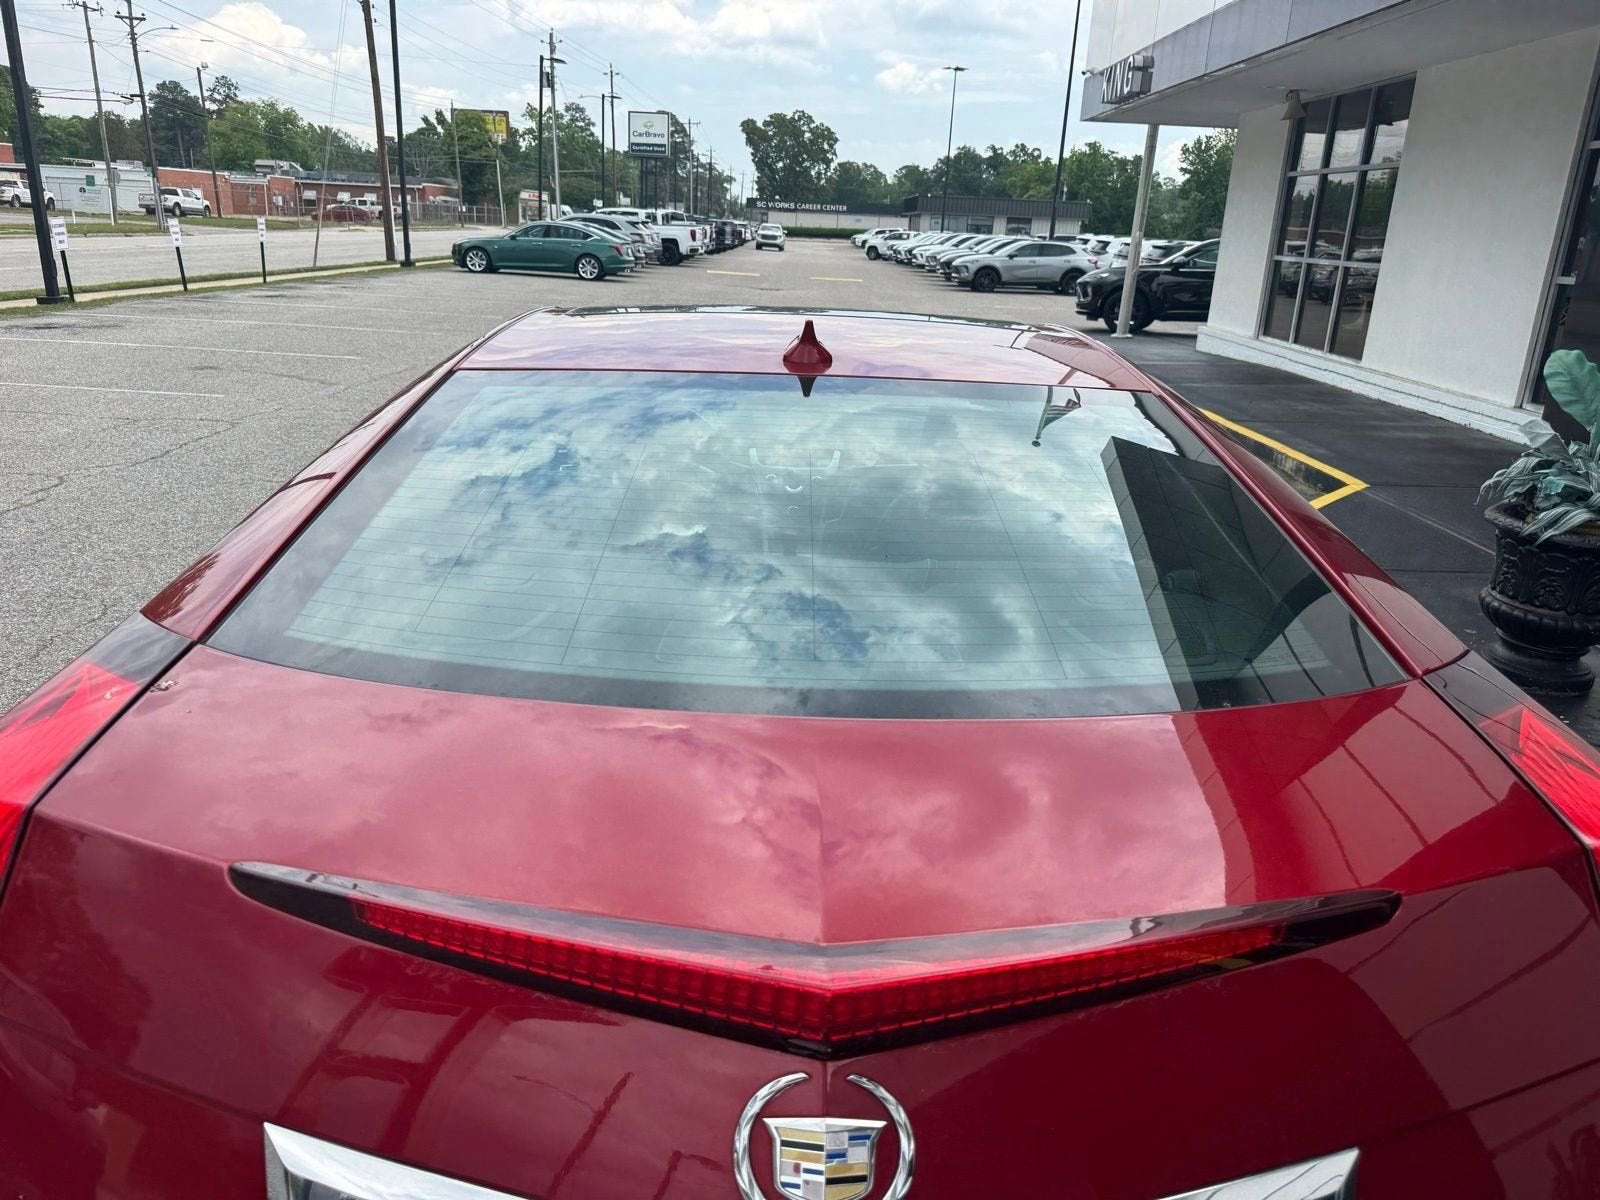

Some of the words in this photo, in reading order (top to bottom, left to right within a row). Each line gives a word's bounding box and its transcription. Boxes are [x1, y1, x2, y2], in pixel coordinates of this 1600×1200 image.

[1101, 54, 1134, 103] KING
[632, 130, 665, 138] CarBravo
[822, 204, 848, 212] CENTER
